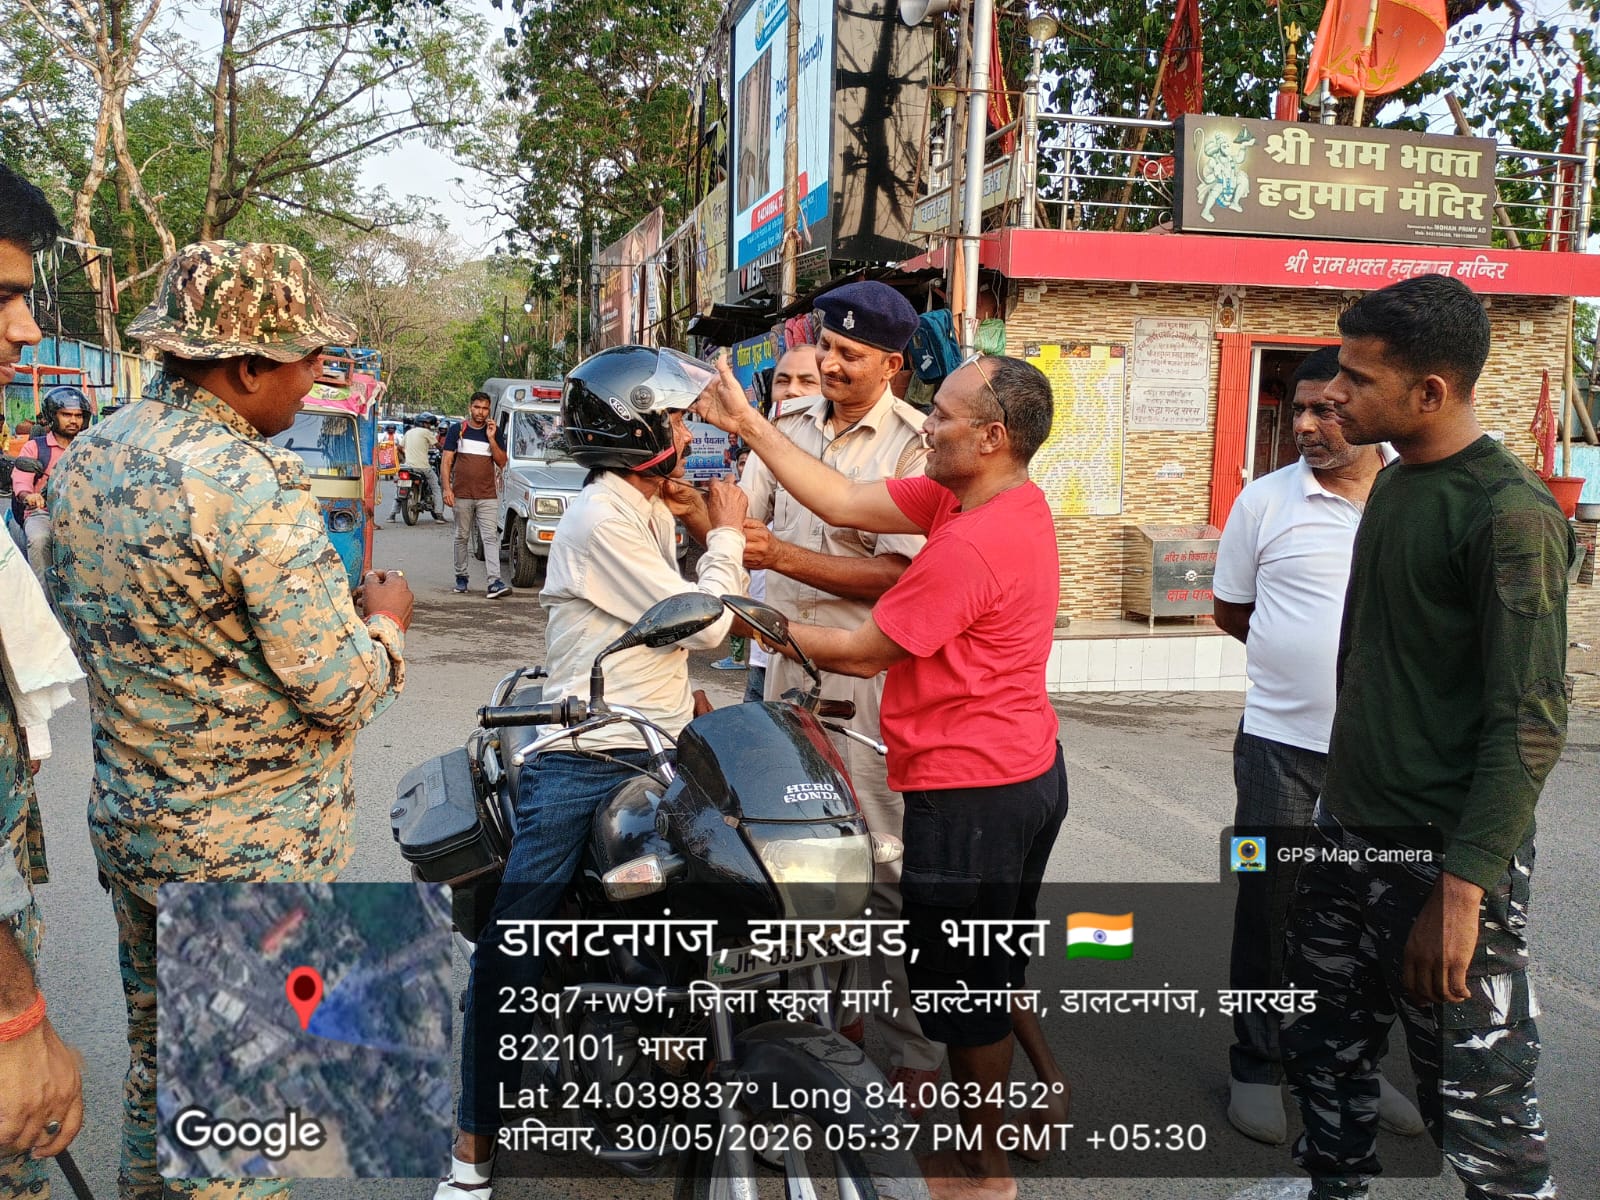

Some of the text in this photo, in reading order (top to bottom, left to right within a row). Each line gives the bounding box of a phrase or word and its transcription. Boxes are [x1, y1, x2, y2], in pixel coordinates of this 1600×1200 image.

[1264, 127, 1483, 179] श्री राम भक्त
[1256, 177, 1489, 221] हनुमान मंदिर
[1284, 249, 1309, 273] श्री
[1457, 255, 1510, 279] मन्दिर
[1167, 588, 1190, 602] दान
[783, 791, 842, 803] HONDA
[786, 783, 834, 794] HERO
